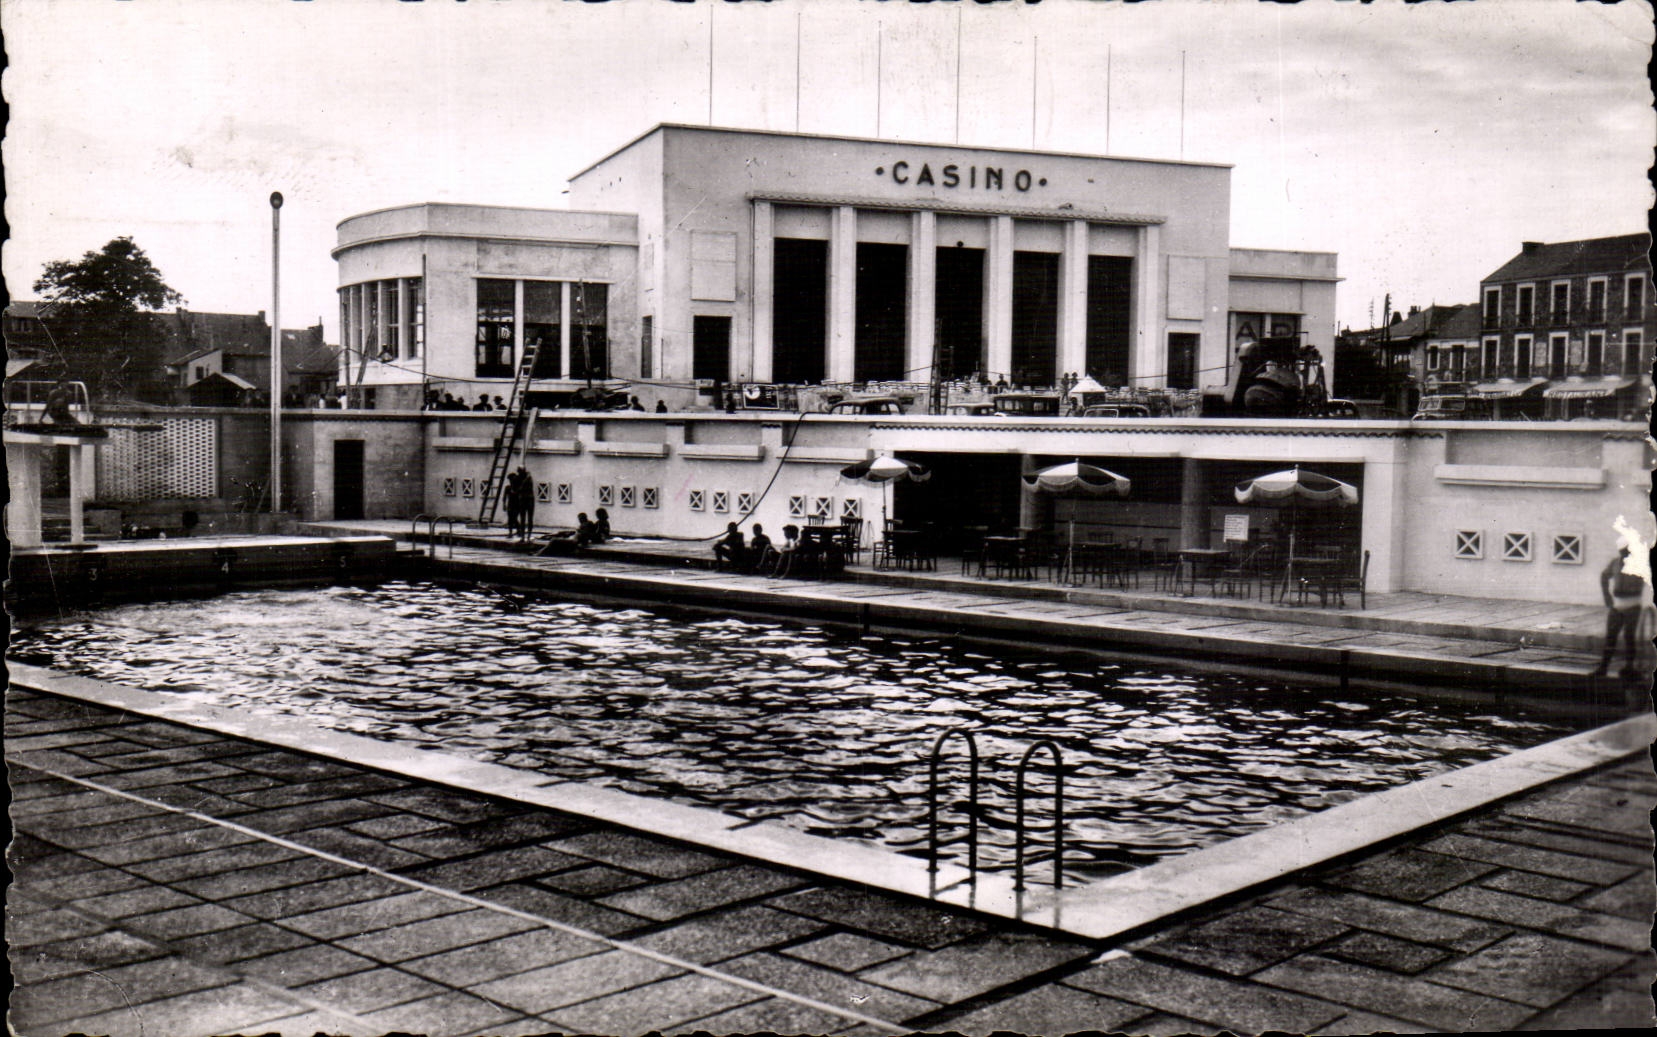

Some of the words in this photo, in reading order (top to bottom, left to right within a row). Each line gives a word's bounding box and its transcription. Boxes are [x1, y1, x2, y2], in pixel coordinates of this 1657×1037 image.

[892, 160, 1032, 192] CASINO
[221, 561, 229, 574] 4
[88, 568, 98, 581] 3
